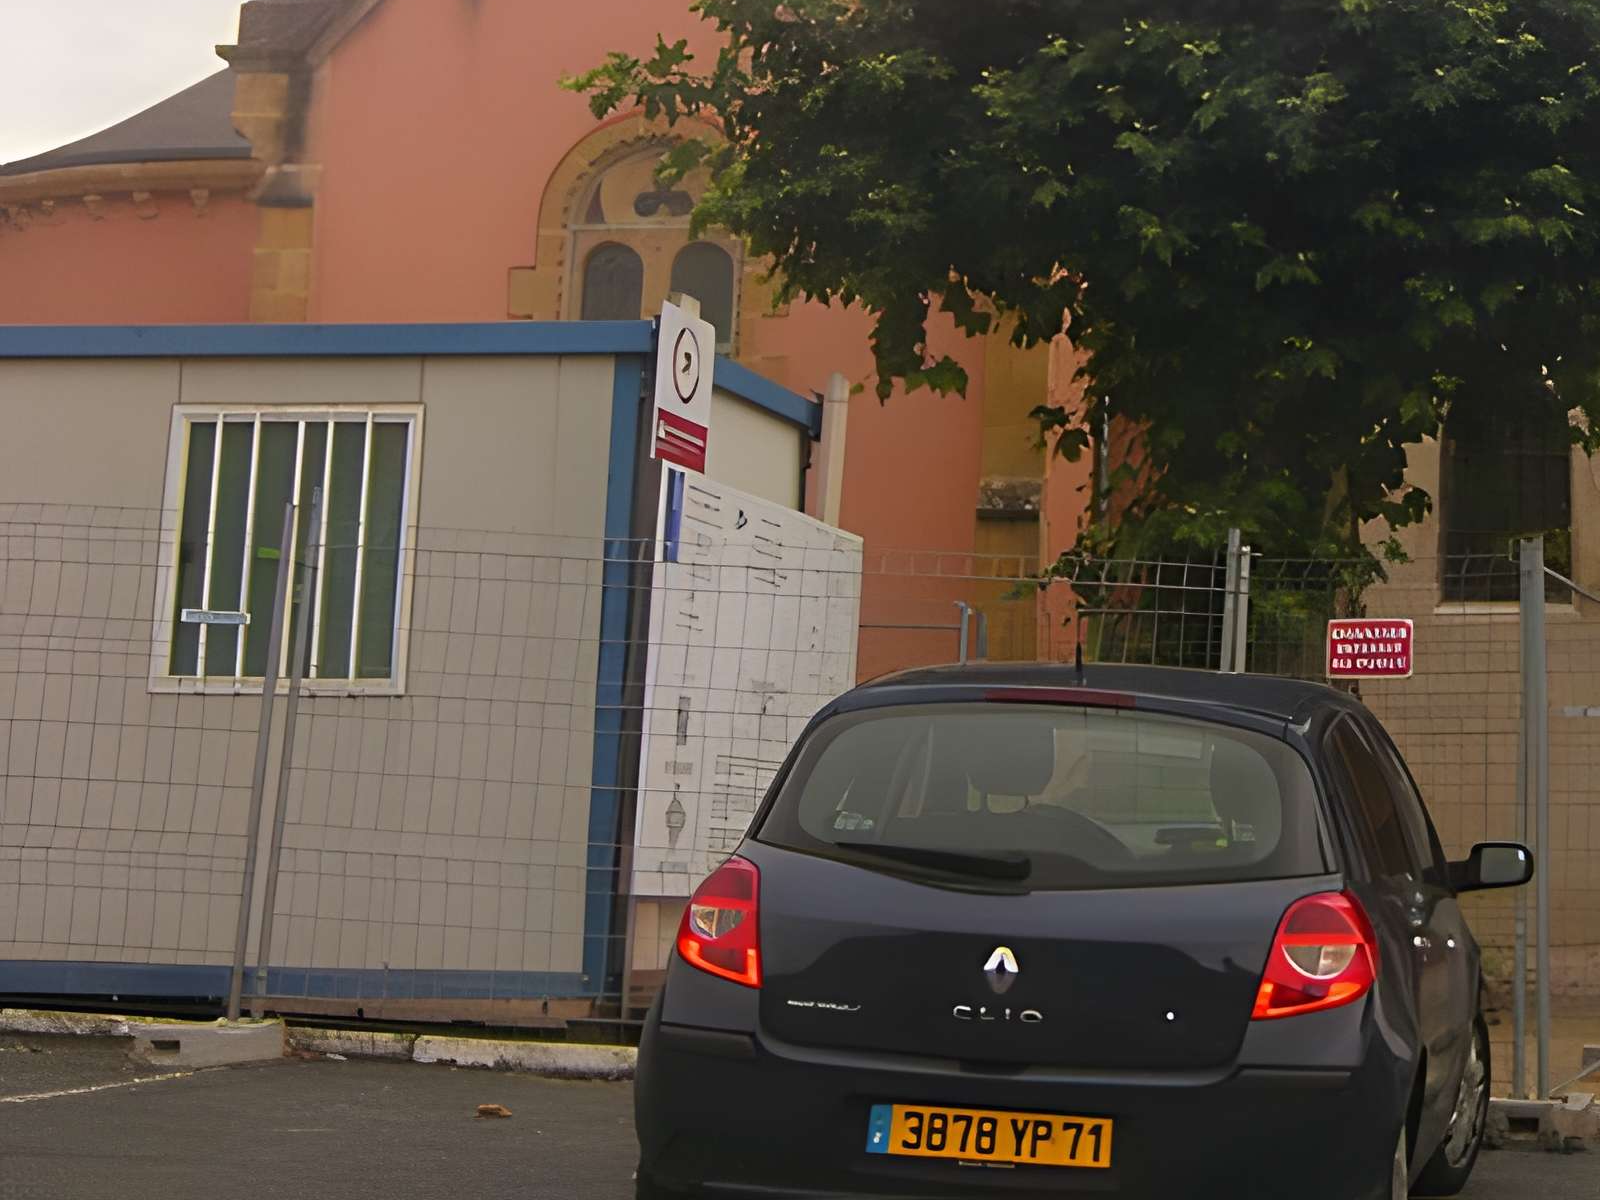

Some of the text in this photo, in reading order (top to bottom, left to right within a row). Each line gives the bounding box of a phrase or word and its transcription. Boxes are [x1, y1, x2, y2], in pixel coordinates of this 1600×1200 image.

[953, 1005, 1043, 1022] CLIO
[901, 1111, 1105, 1162] 3878 YP 71
